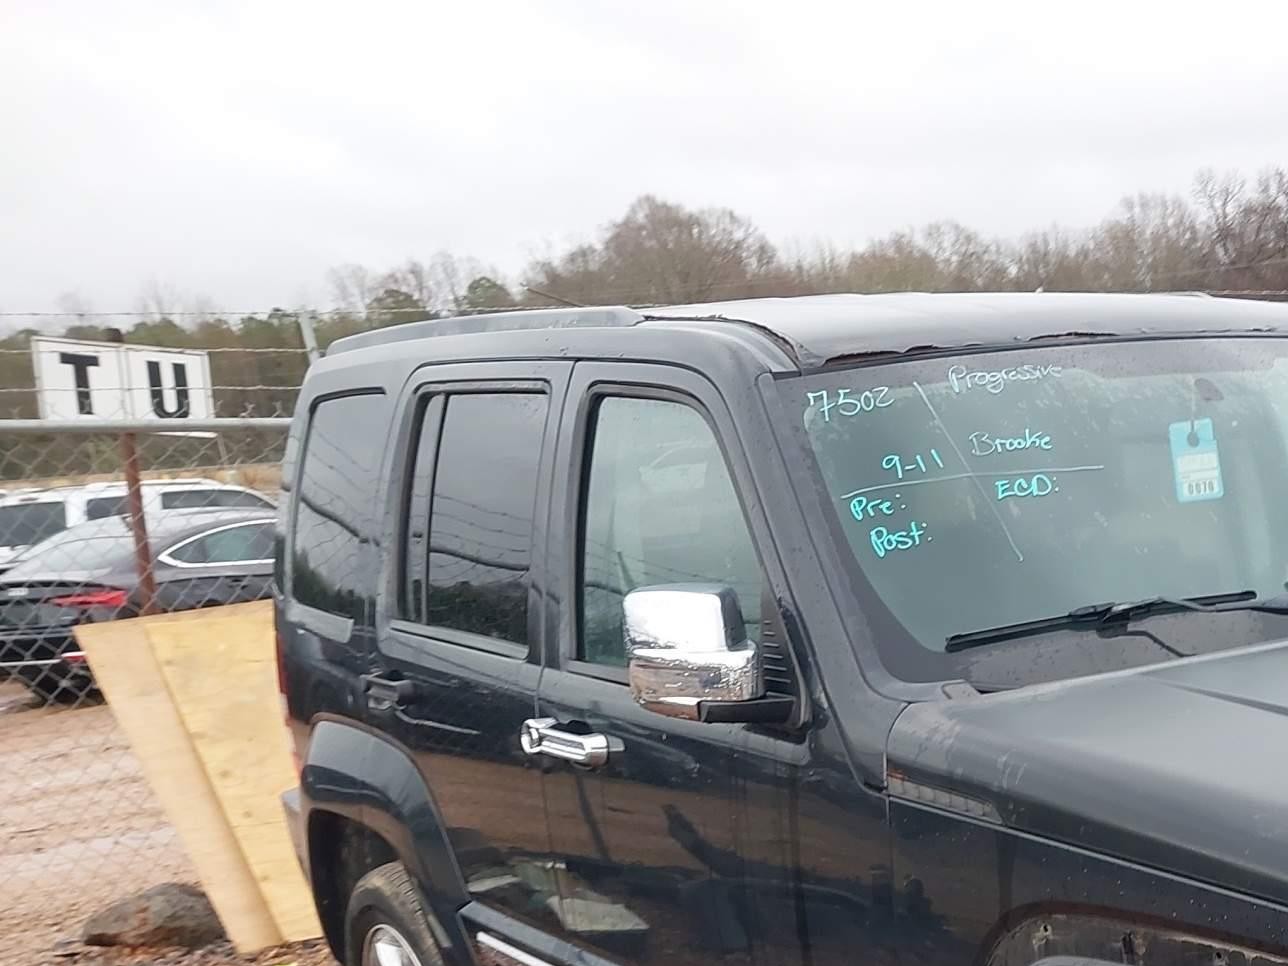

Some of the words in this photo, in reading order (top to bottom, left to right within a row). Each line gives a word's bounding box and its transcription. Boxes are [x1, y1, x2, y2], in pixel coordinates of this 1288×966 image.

[59, 352, 99, 415] T
[147, 360, 190, 419] U
[948, 364, 1062, 393] Progressive
[807, 386, 895, 422] 7502
[968, 428, 1053, 456] Brooke
[882, 448, 944, 479] 9-11
[870, 521, 932, 558] Post:
